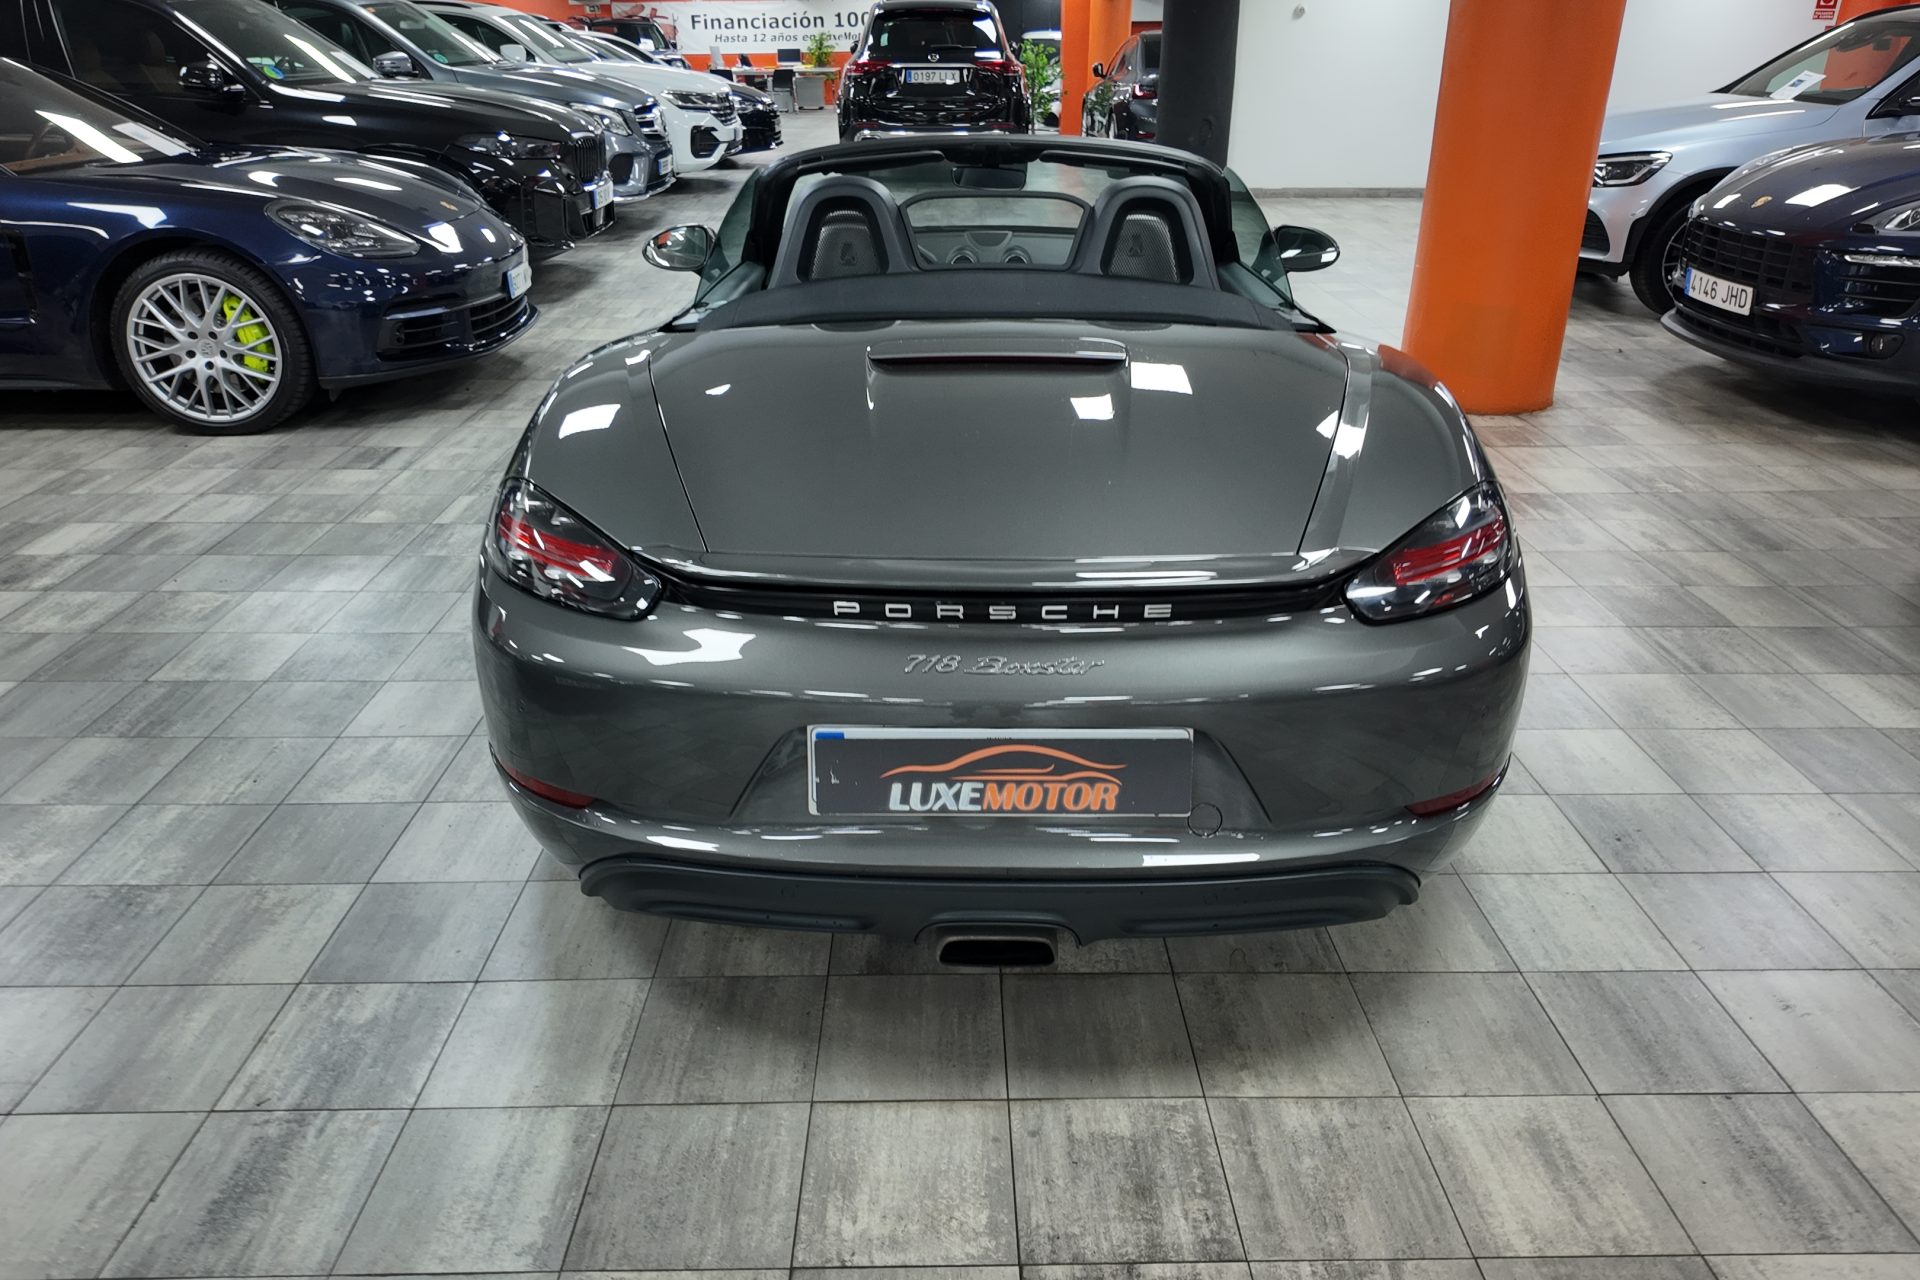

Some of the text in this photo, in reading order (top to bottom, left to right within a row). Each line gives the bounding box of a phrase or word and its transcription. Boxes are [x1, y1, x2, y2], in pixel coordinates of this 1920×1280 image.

[690, 10, 825, 30] Financiación
[714, 33, 748, 43] Hasta
[753, 33, 767, 42] 12
[770, 32, 799, 42] años
[913, 71, 936, 81] 0197
[1690, 274, 1748, 309] 4146 JHD
[833, 600, 1172, 620] PORSCHE
[904, 654, 1105, 676] 718 Boxster
[888, 781, 1121, 812] LUXEMOTOR
